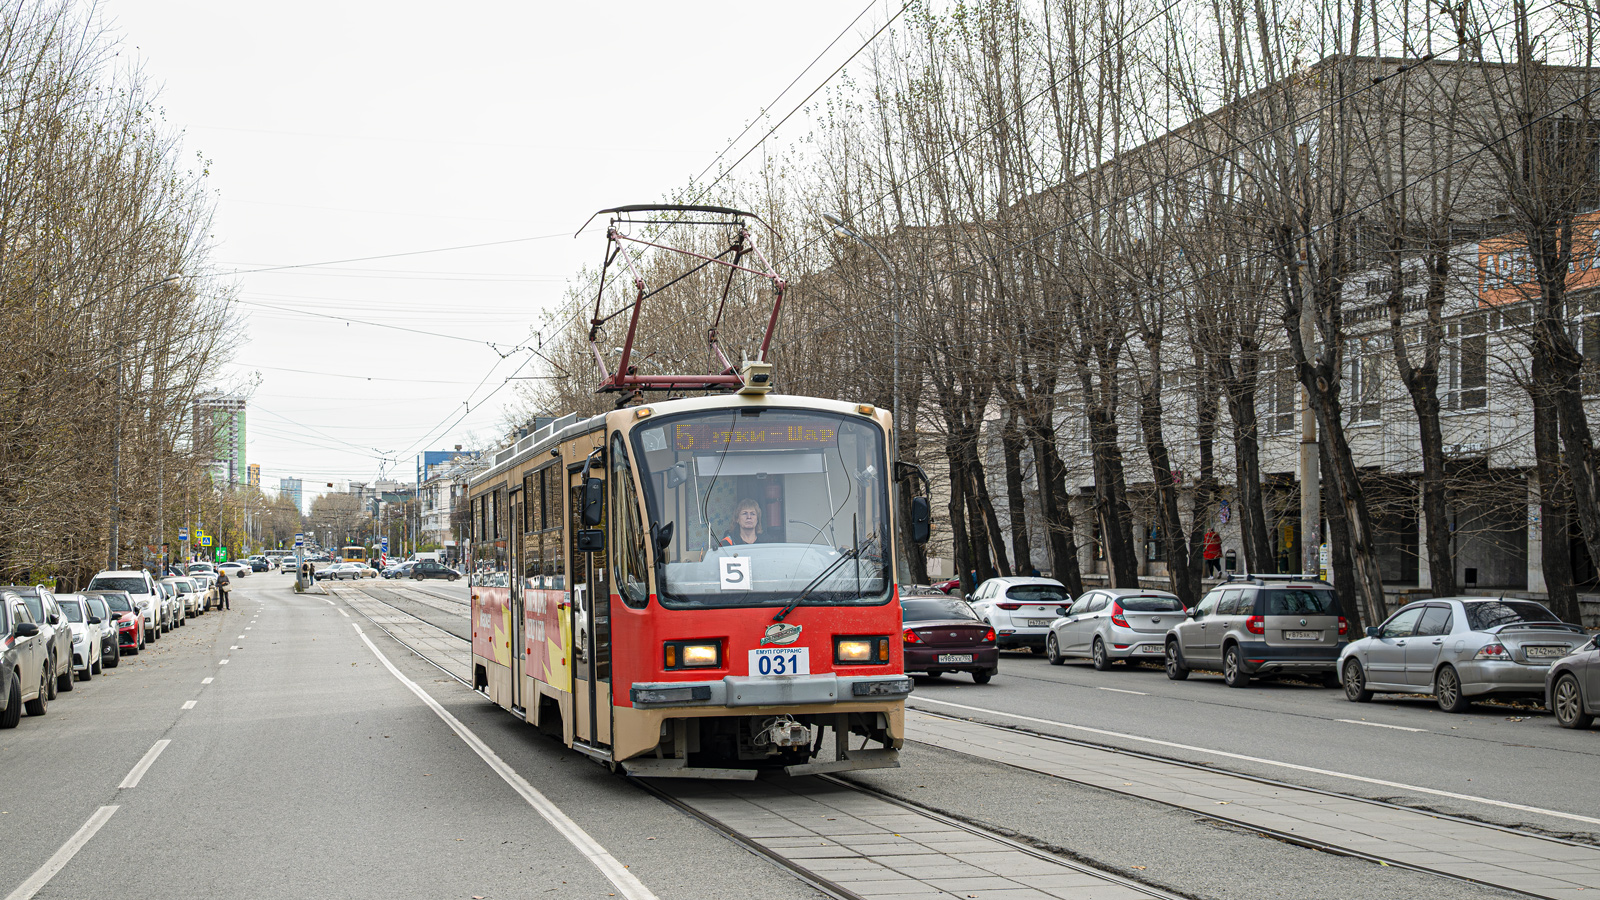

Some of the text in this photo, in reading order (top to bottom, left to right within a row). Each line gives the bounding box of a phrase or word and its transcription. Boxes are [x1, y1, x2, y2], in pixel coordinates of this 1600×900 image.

[676, 424, 694, 450] 5
[725, 562, 744, 584] 5
[758, 654, 797, 675] 031
